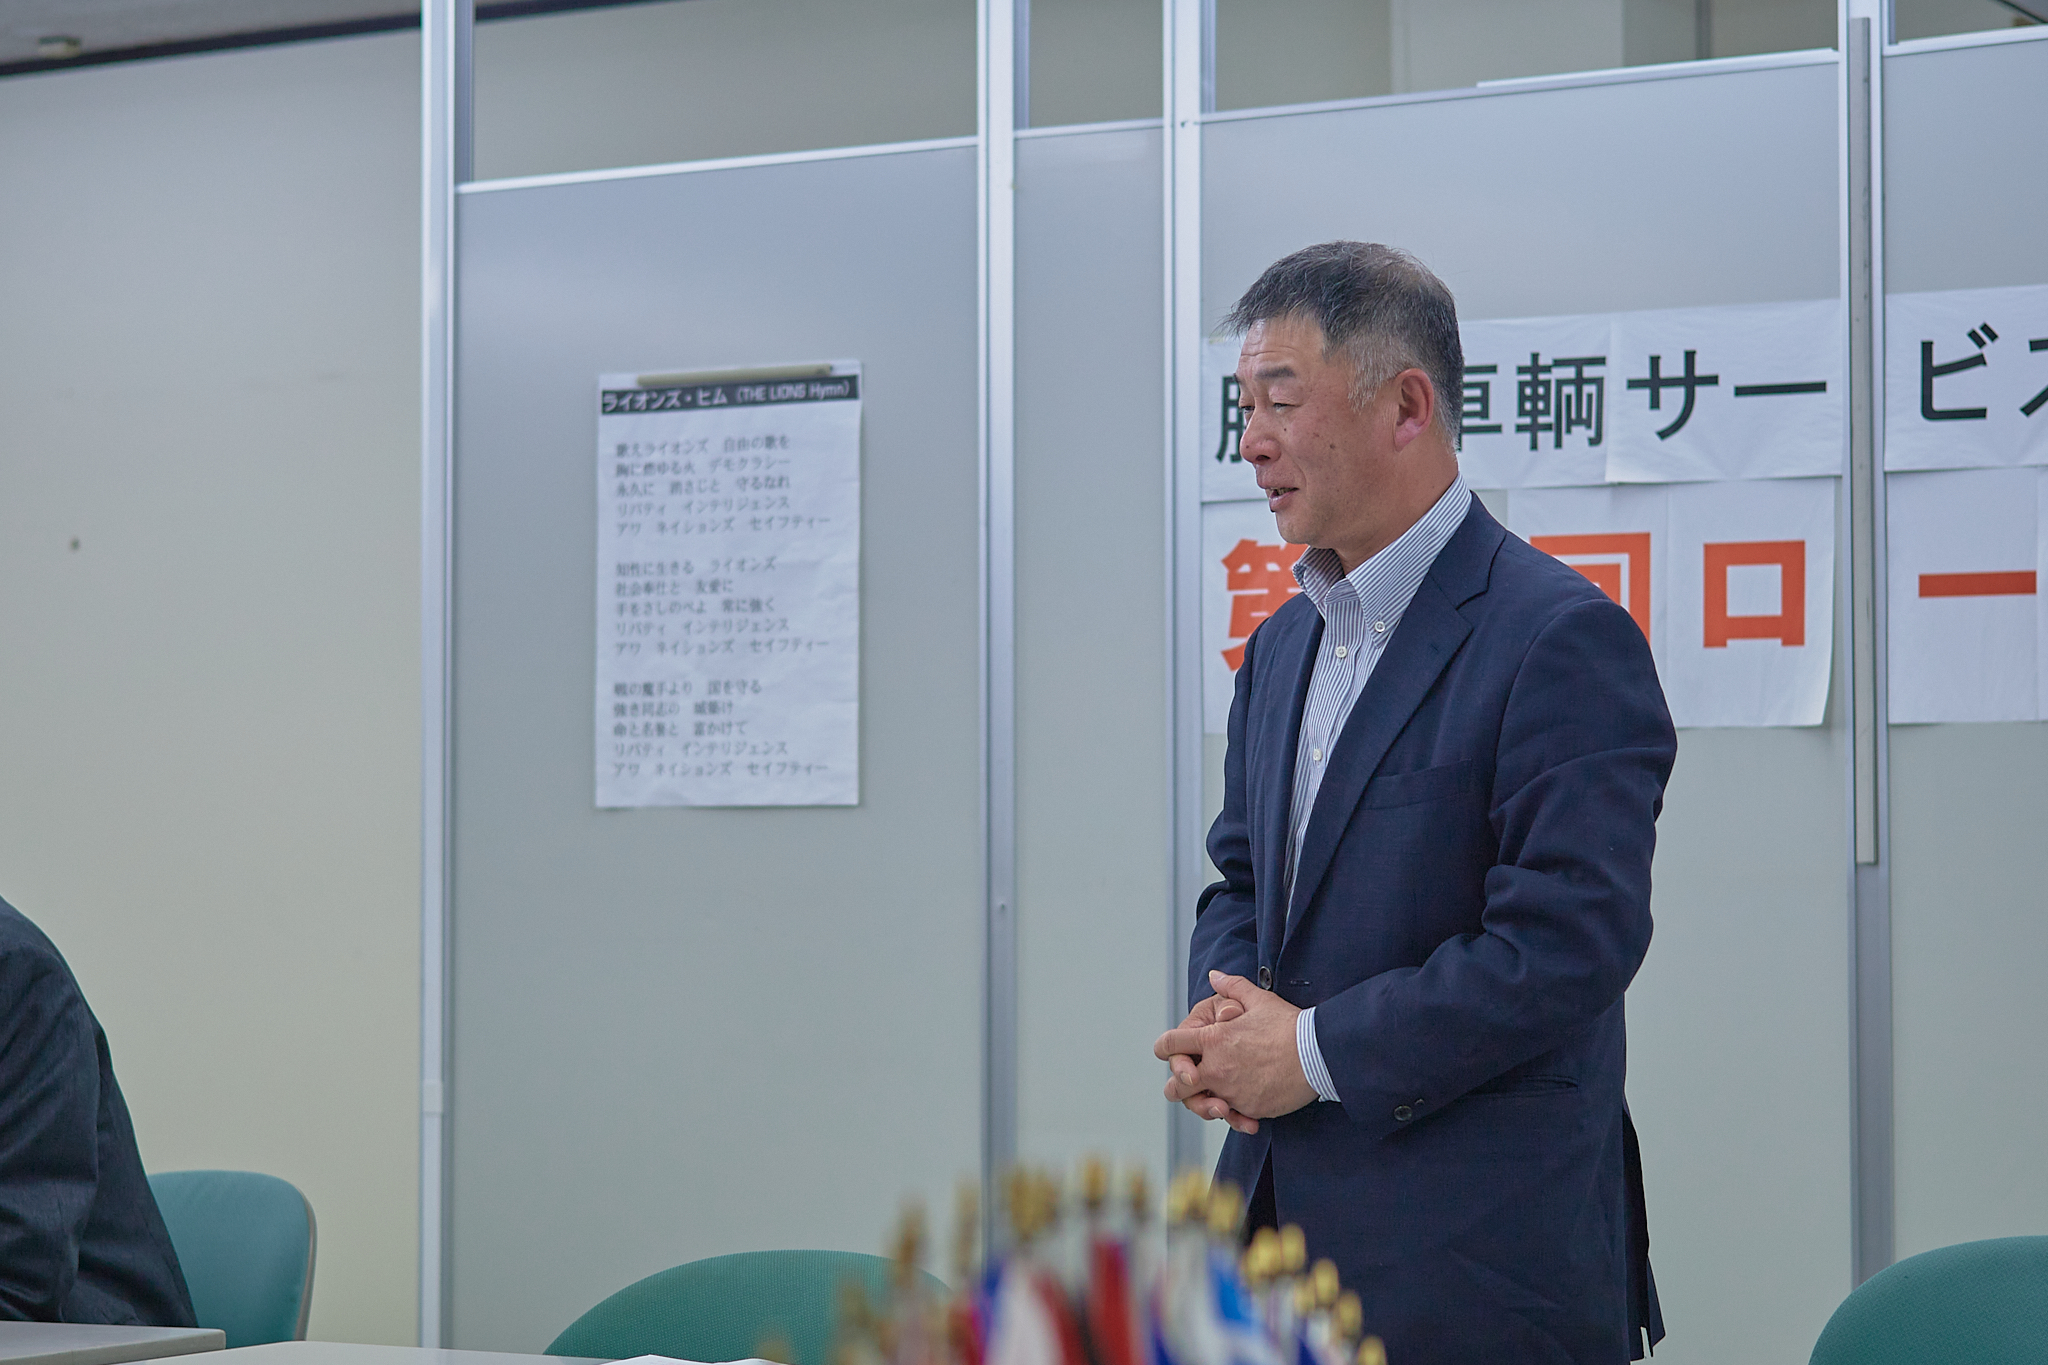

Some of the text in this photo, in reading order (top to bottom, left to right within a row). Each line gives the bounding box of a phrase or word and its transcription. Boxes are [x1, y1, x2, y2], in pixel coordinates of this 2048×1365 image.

[603, 387, 728, 412] ライオンズ・ヒム
[768, 382, 806, 401] LIONS
